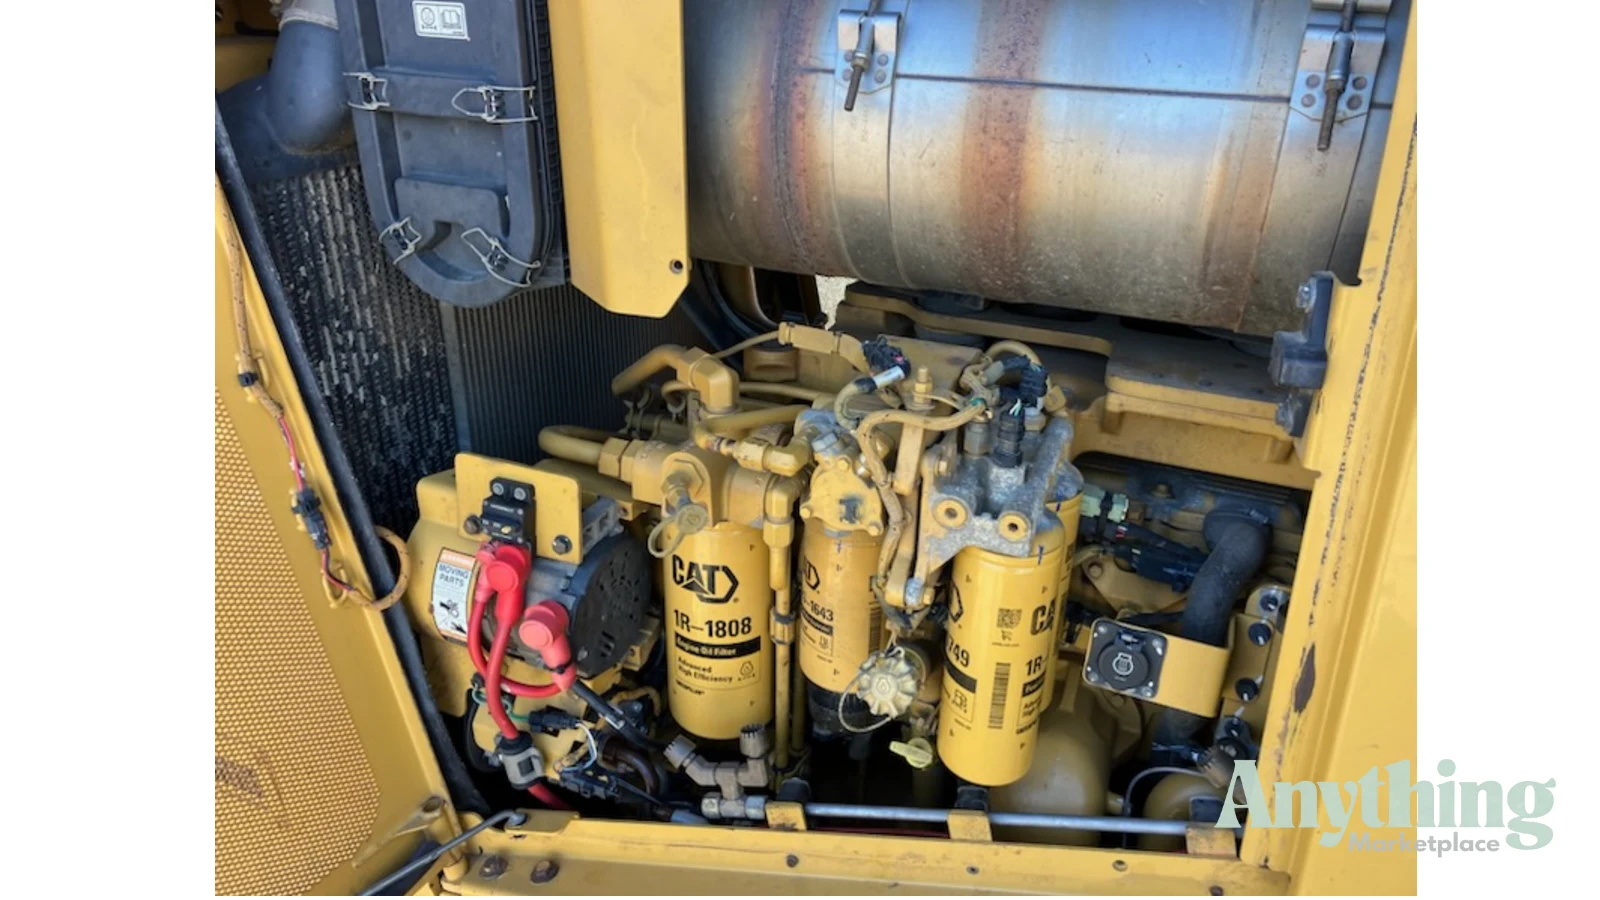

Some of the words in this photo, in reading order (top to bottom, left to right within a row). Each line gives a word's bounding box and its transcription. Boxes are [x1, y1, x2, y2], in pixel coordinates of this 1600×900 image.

[439, 564, 469, 579] MOVING
[672, 554, 721, 596] CAT
[439, 573, 464, 587] PARTS
[714, 647, 736, 656] Filter
[678, 657, 712, 673] Advanced
[694, 671, 733, 683] Efficiency
